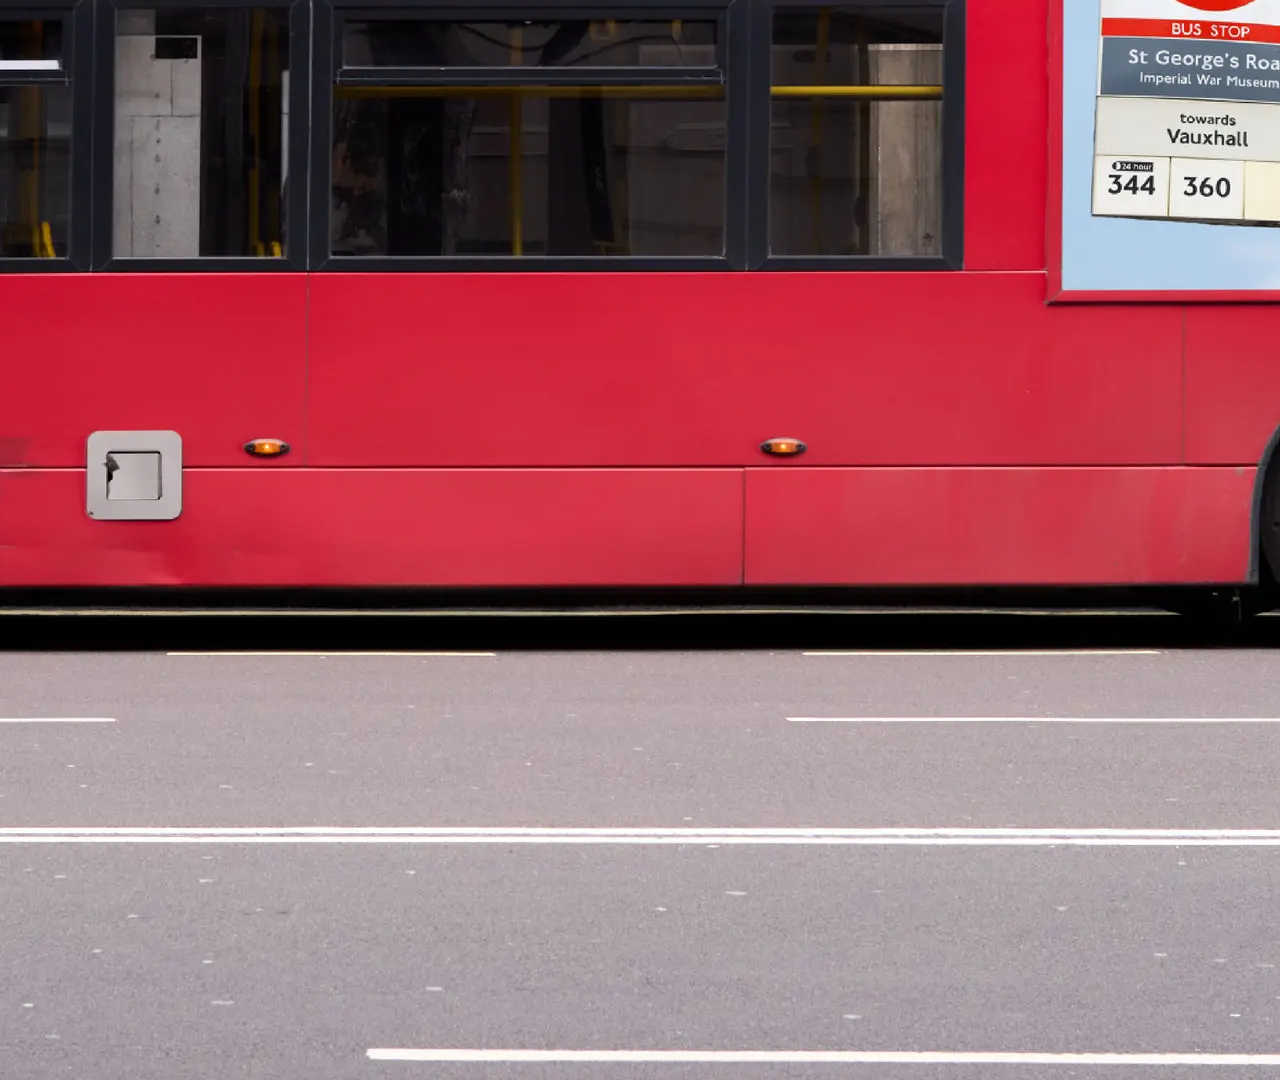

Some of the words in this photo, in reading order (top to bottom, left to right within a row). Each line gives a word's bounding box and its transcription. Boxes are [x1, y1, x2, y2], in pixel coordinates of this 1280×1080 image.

[1171, 23, 1202, 36] BUS
[1210, 24, 1251, 38] STOP
[1128, 48, 1149, 65] St
[1155, 49, 1240, 71] George's
[1139, 71, 1192, 87] Imperial
[1196, 74, 1222, 86] War
[1226, 75, 1280, 89] Museum
[1179, 113, 1237, 126] towards
[1166, 128, 1249, 147] Vauxhall
[1133, 163, 1152, 171] hour
[1108, 174, 1156, 196] 344
[1183, 176, 1231, 198] 360
